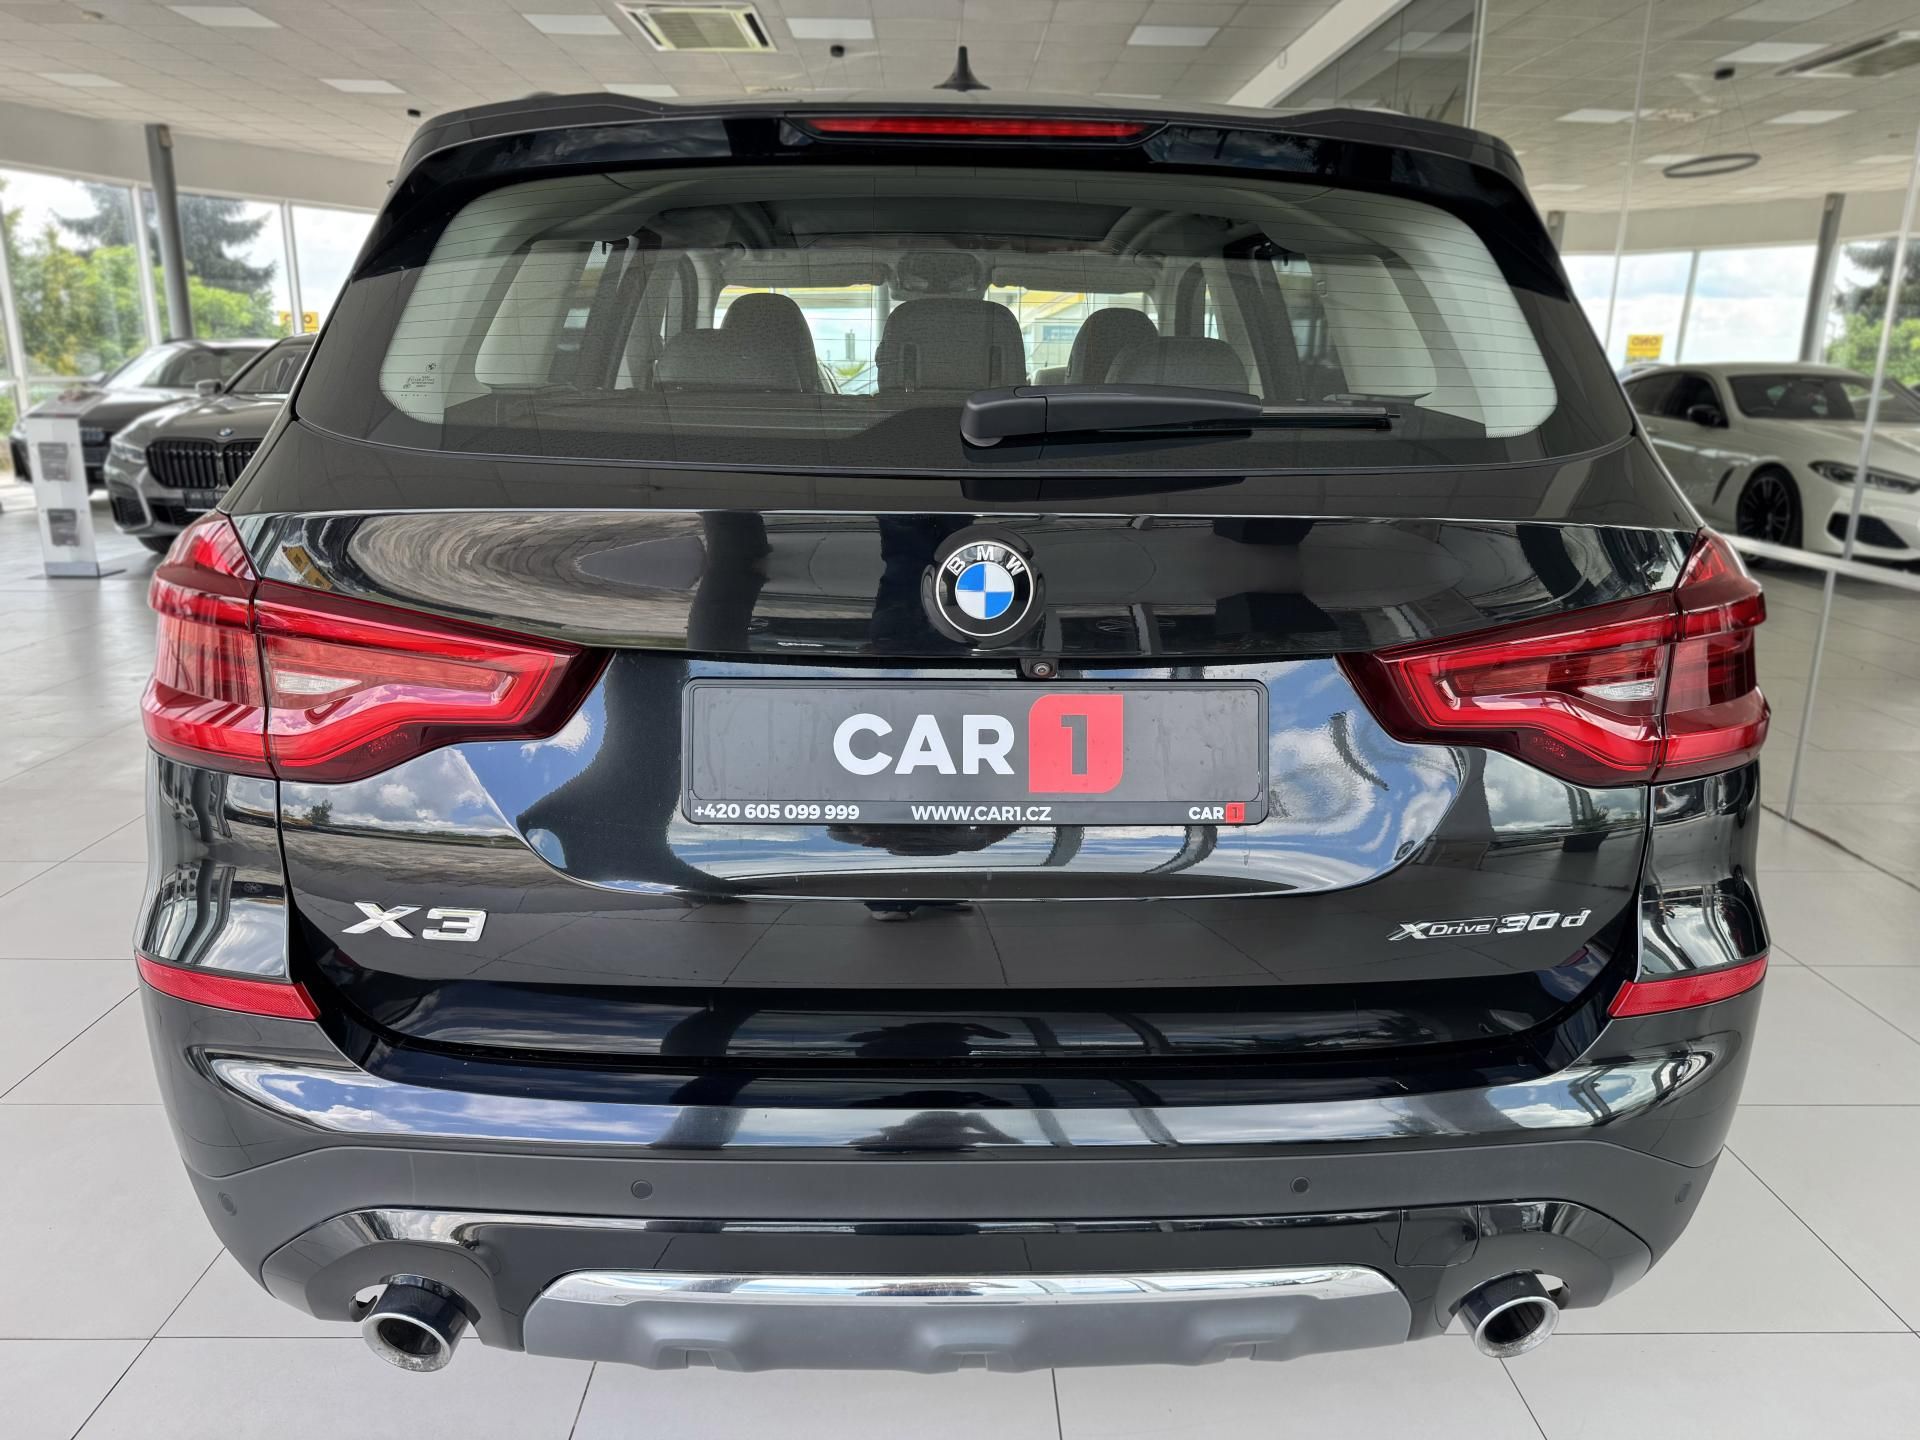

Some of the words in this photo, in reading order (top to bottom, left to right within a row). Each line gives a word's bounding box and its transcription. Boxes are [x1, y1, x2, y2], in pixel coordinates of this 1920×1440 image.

[947, 546, 1025, 576] BMW
[695, 803, 741, 819] +420
[744, 804, 781, 819] 605
[784, 804, 821, 820] 099
[824, 804, 860, 820] 999
[911, 805, 1052, 821] WWW.CAR1.CZ
[341, 901, 488, 942] X3
